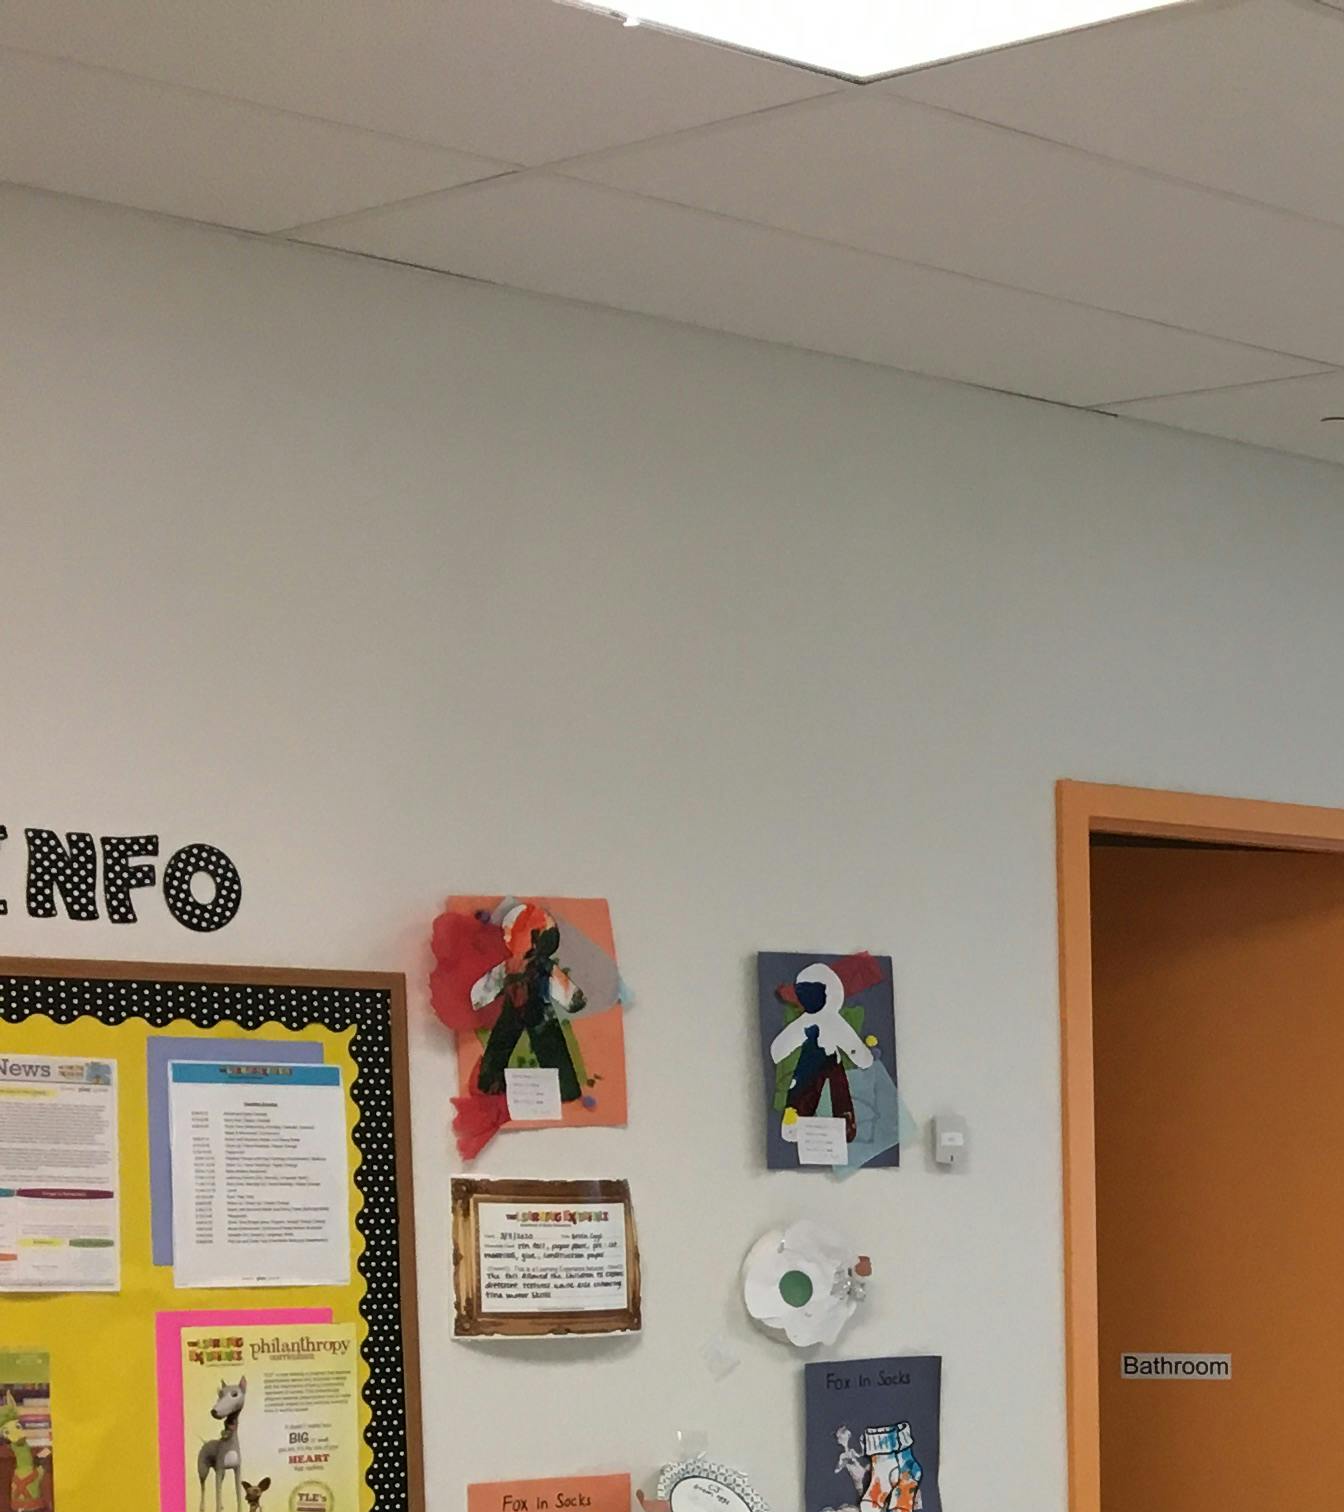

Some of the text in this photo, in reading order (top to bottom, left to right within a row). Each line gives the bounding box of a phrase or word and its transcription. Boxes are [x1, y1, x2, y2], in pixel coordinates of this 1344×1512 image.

[250, 1336, 351, 1361] philanthropy
[1124, 1355, 1229, 1375] Bathroom
[826, 1372, 851, 1391] Fox
[876, 1369, 912, 1387] Socks
[288, 1431, 309, 1445] BIG
[288, 1454, 330, 1464] HEART
[502, 1494, 528, 1512] Fox
[555, 1491, 592, 1509] Socks
